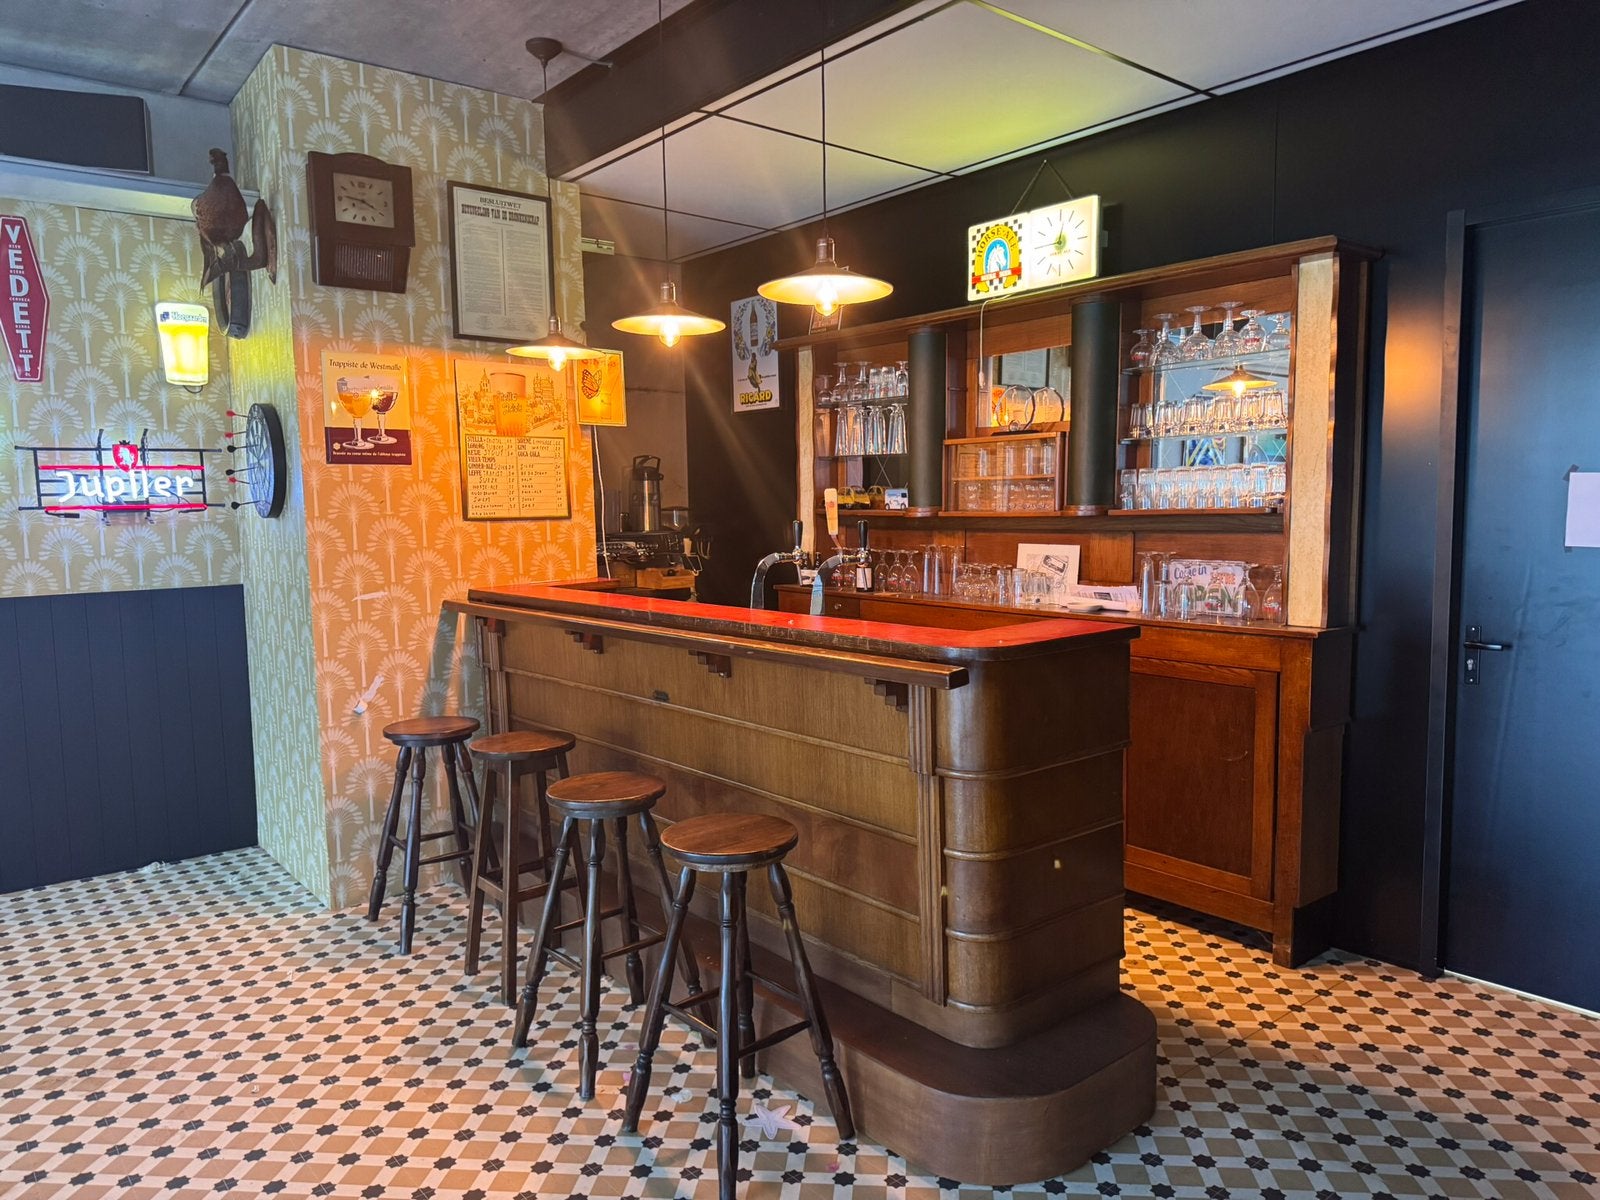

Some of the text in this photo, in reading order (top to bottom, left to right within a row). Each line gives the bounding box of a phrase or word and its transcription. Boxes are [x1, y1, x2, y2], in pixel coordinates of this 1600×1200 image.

[5, 224, 33, 372] VEDETT
[329, 359, 358, 369] Trappiste
[370, 362, 402, 370] Westmalle
[740, 390, 773, 405] RICARD
[55, 469, 194, 503] Jupiler
[1198, 565, 1207, 575] in
